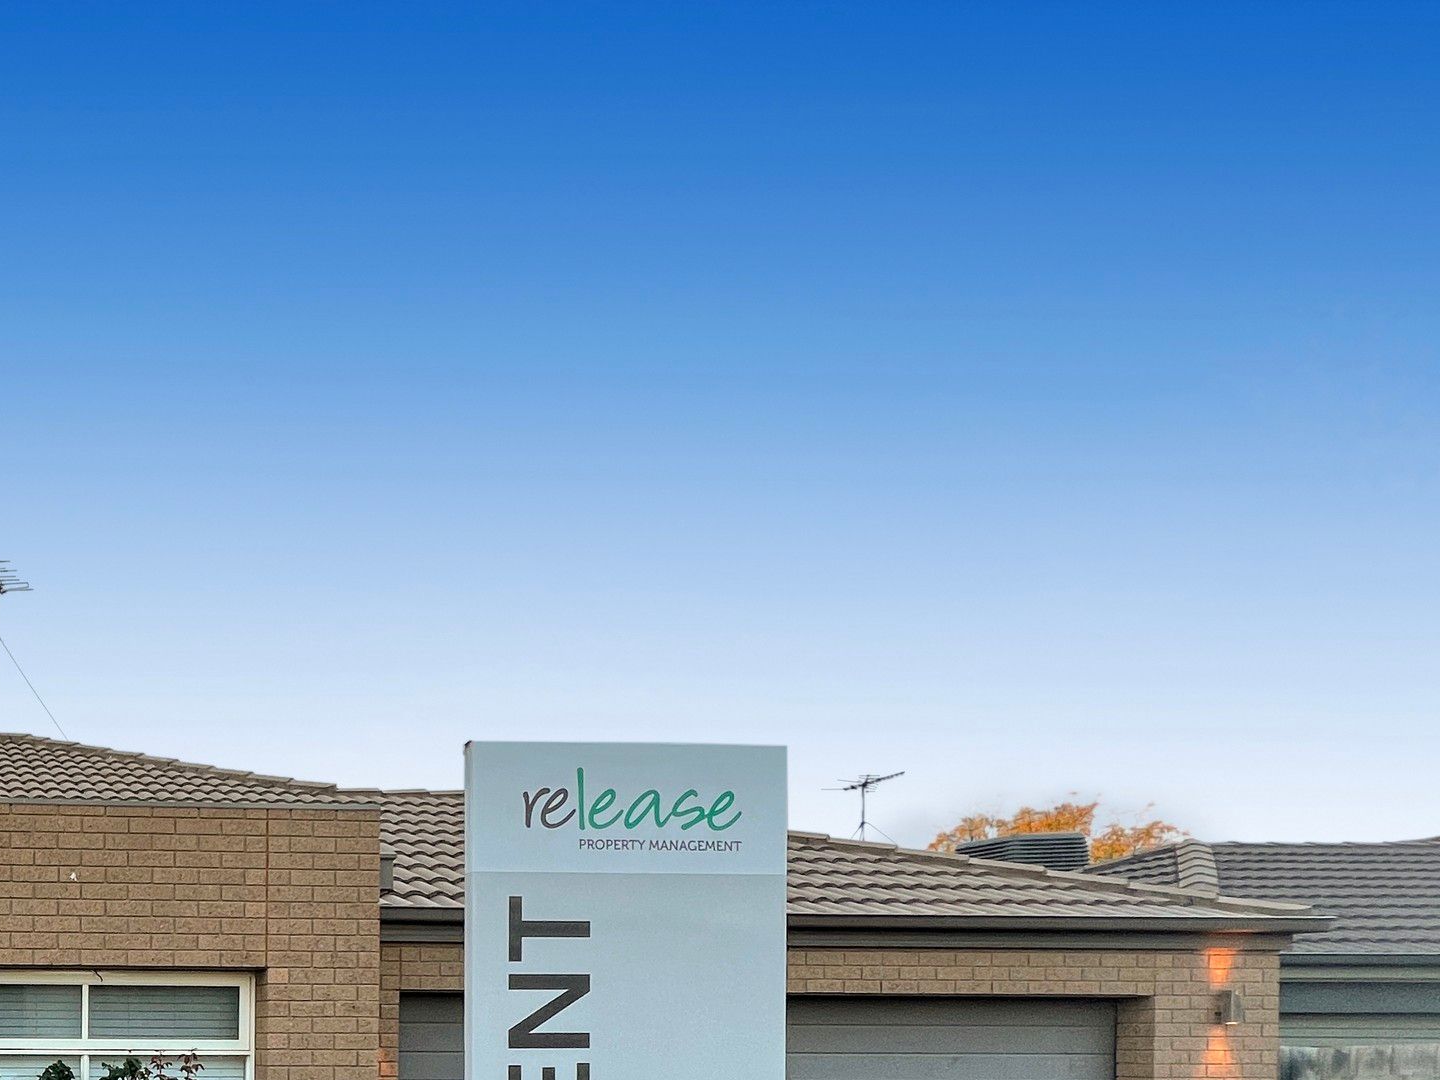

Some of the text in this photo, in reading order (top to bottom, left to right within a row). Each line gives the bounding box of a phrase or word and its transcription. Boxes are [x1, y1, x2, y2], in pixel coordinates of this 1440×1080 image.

[521, 766, 743, 831] release
[578, 838, 743, 852] PROPERTY MANAGEMENT
